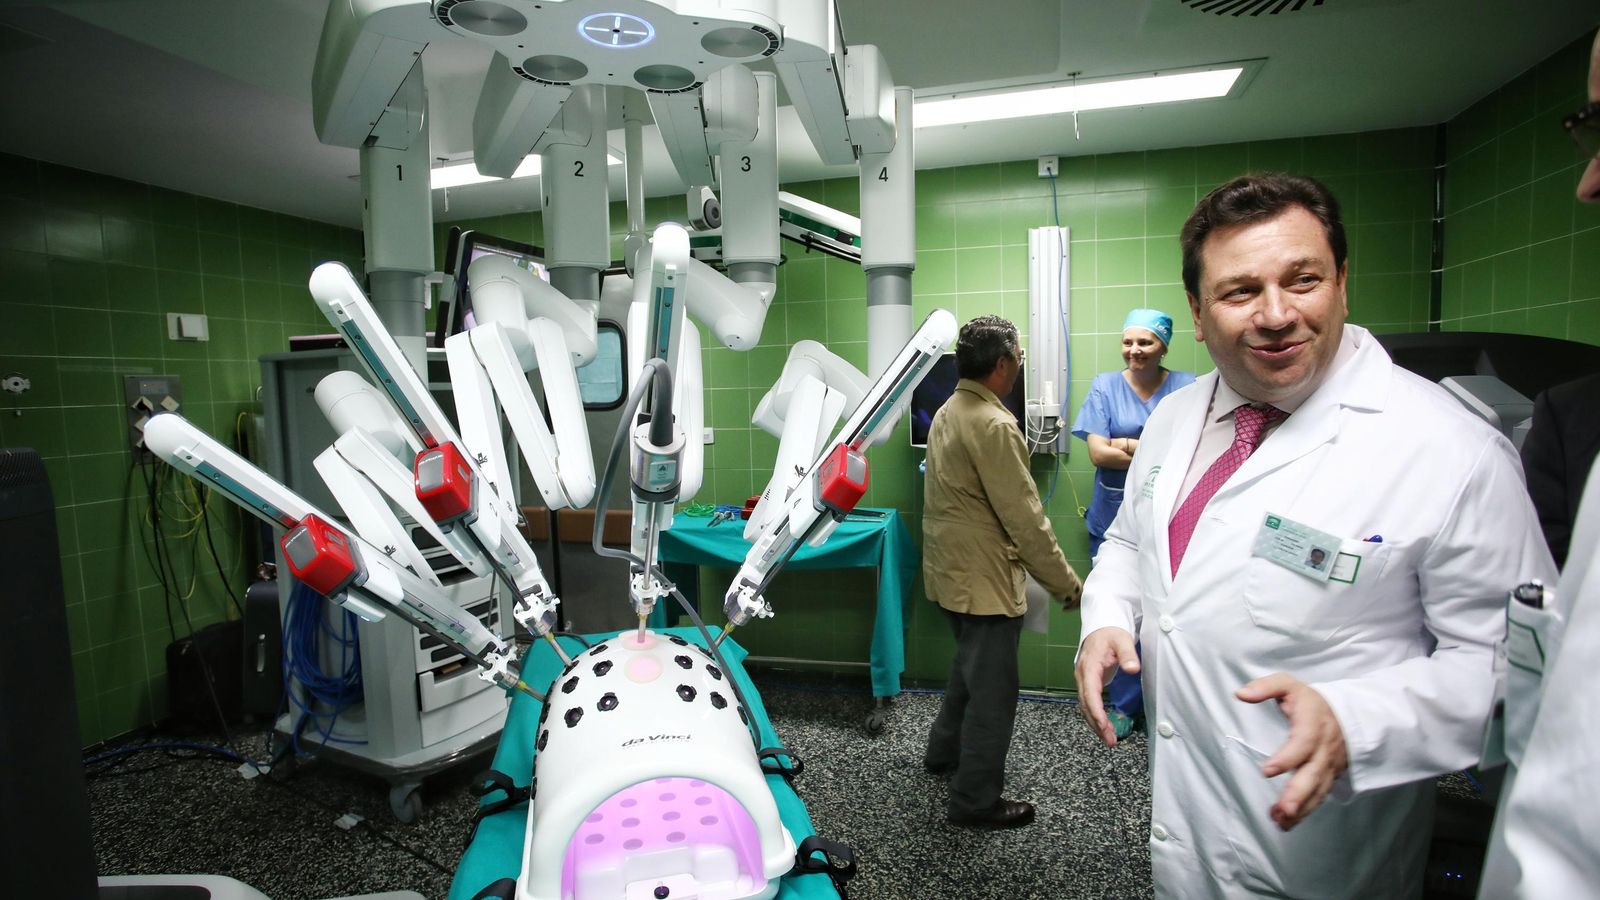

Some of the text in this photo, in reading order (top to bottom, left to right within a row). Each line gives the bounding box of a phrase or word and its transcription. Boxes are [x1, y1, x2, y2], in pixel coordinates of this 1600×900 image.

[574, 161, 584, 177] 2
[741, 156, 751, 172] 3
[396, 165, 403, 181] 1
[879, 167, 889, 182] 4
[621, 737, 645, 747] da
[648, 733, 691, 741] Vinci
